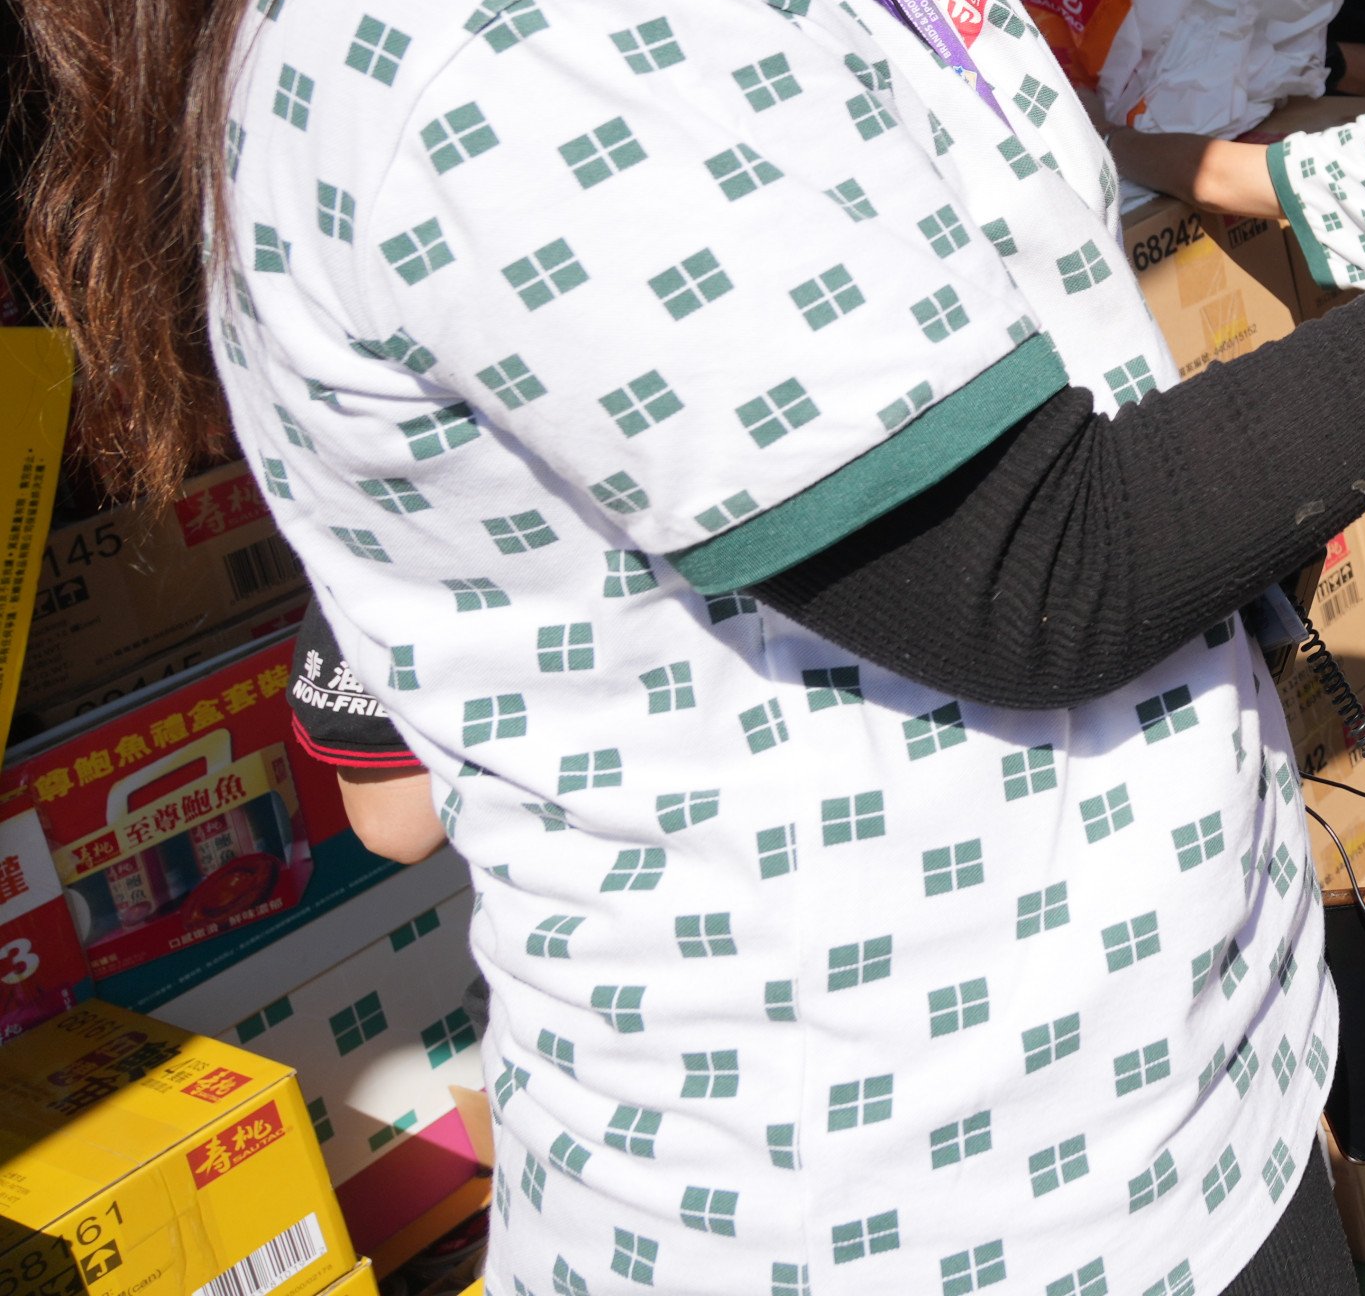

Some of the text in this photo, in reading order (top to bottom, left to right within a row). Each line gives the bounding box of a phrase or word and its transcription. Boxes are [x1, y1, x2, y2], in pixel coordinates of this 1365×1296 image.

[920, 0, 939, 23] EXPO
[925, 23, 952, 60] BRANDS
[1133, 213, 1205, 272] 68242
[33, 664, 291, 802] 尊鮑魚禮盒套裝
[124, 774, 247, 846] 至尊鮑魚
[196, 1119, 272, 1174] 寿桃
